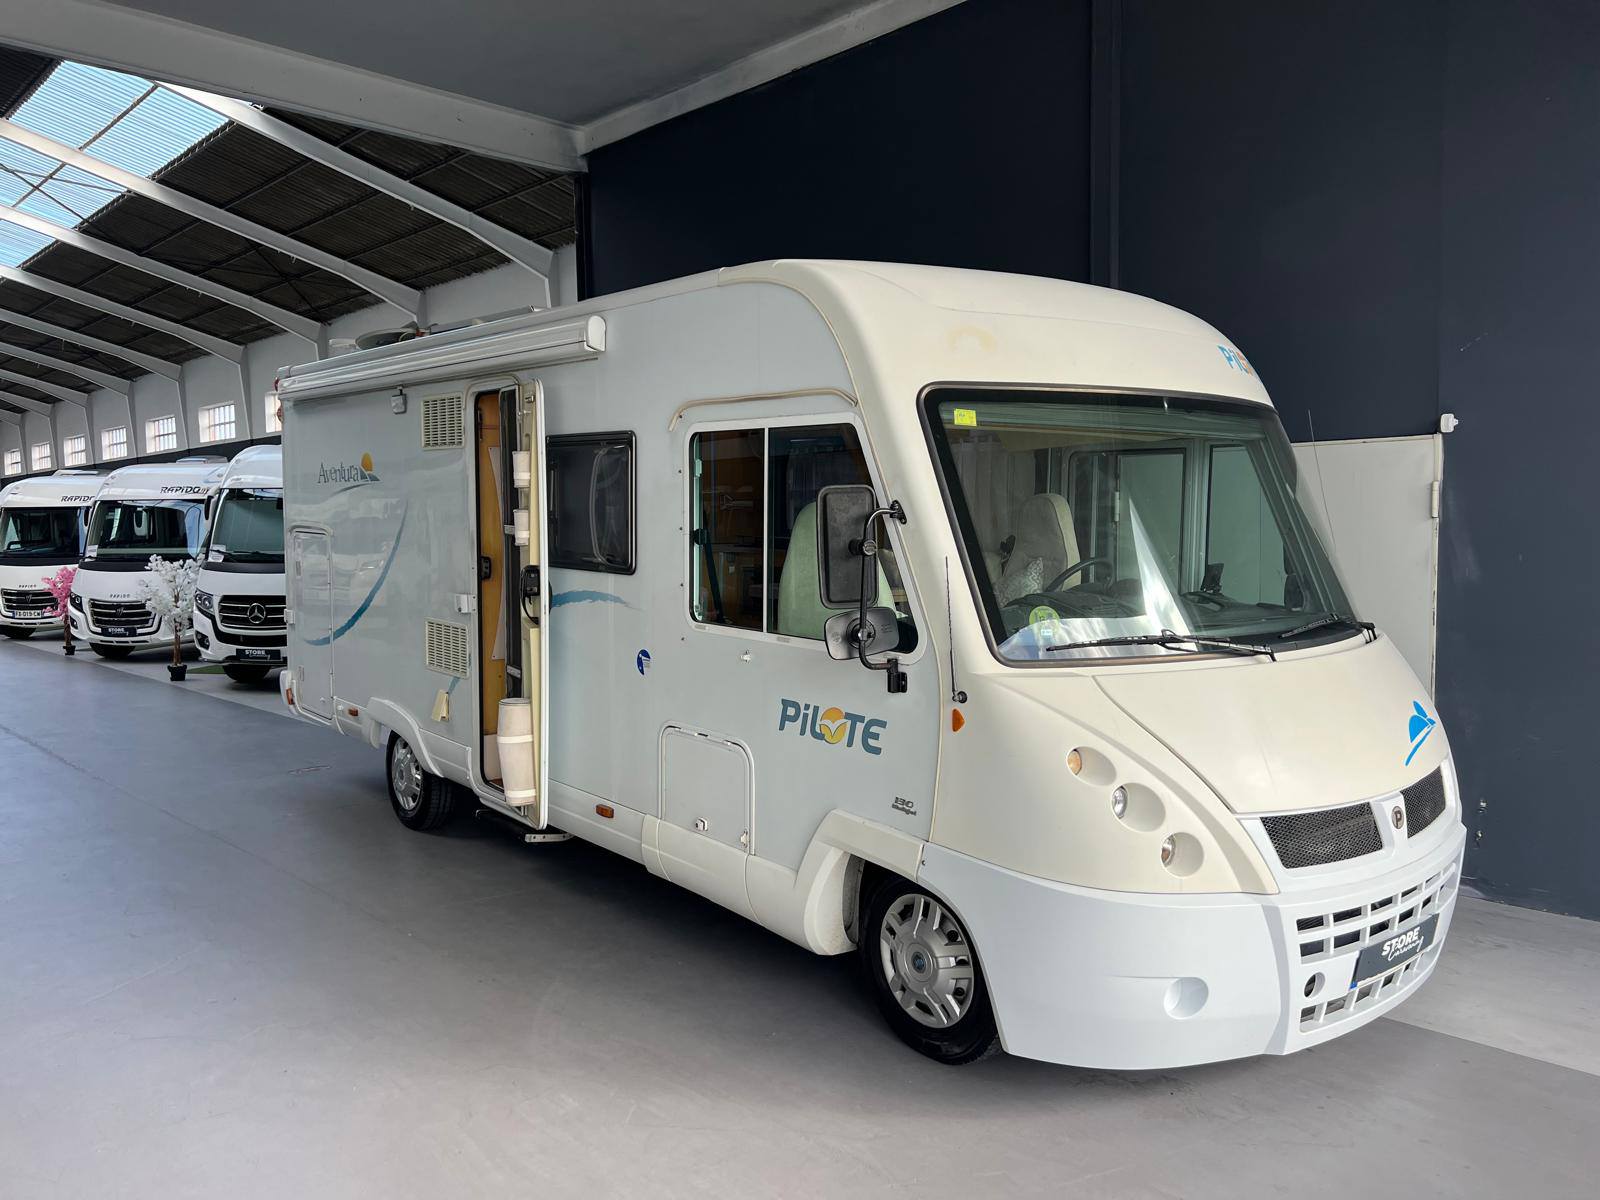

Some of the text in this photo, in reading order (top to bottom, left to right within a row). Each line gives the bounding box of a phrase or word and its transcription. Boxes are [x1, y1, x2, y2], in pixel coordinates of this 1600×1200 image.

[317, 461, 360, 484] Aventura
[160, 486, 200, 494] RAPIDO
[1381, 926, 1421, 956] STORE
